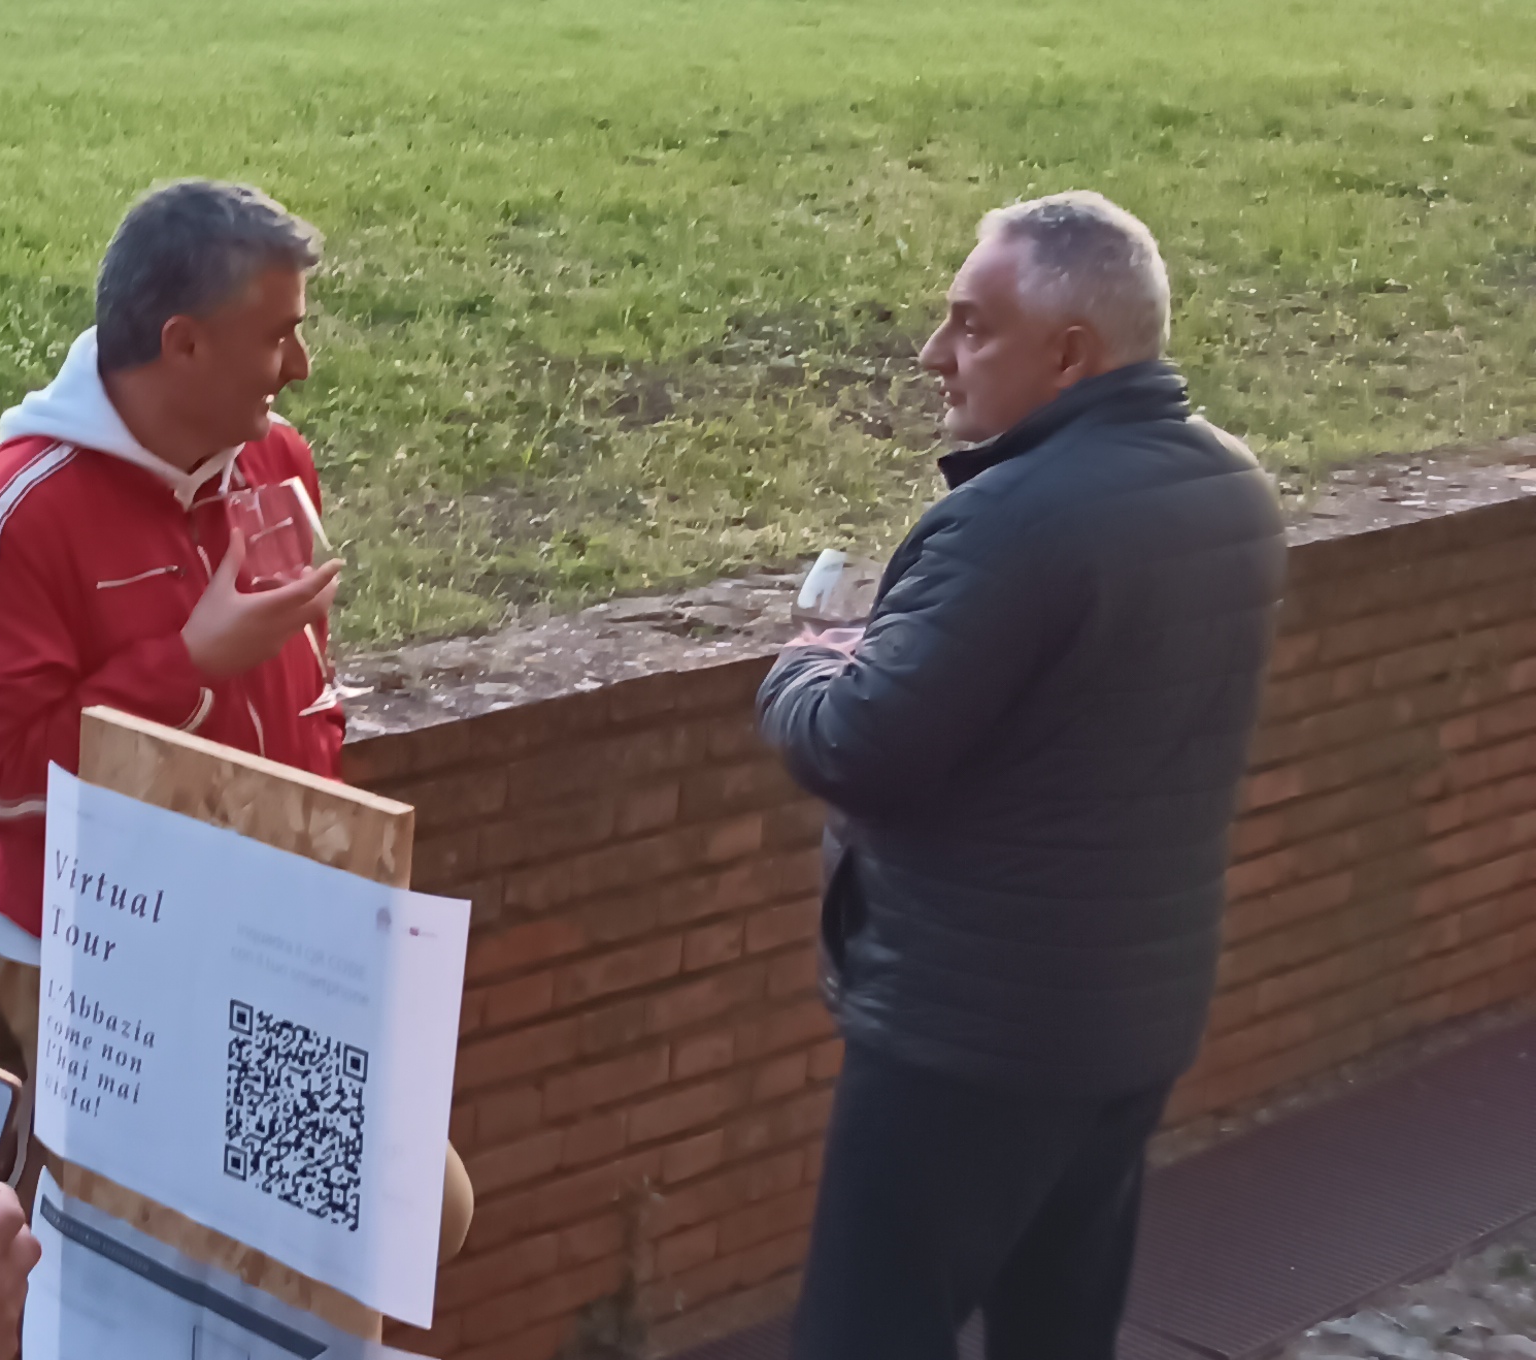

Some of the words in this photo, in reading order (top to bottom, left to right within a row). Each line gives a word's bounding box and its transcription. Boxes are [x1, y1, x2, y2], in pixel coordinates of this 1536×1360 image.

[56, 849, 164, 923] Virtual
[52, 904, 116, 961] Tour
[48, 979, 155, 1048] L'Abbazia
[47, 1015, 92, 1050] come
[101, 1043, 142, 1074] non
[97, 1073, 140, 1104] mai
